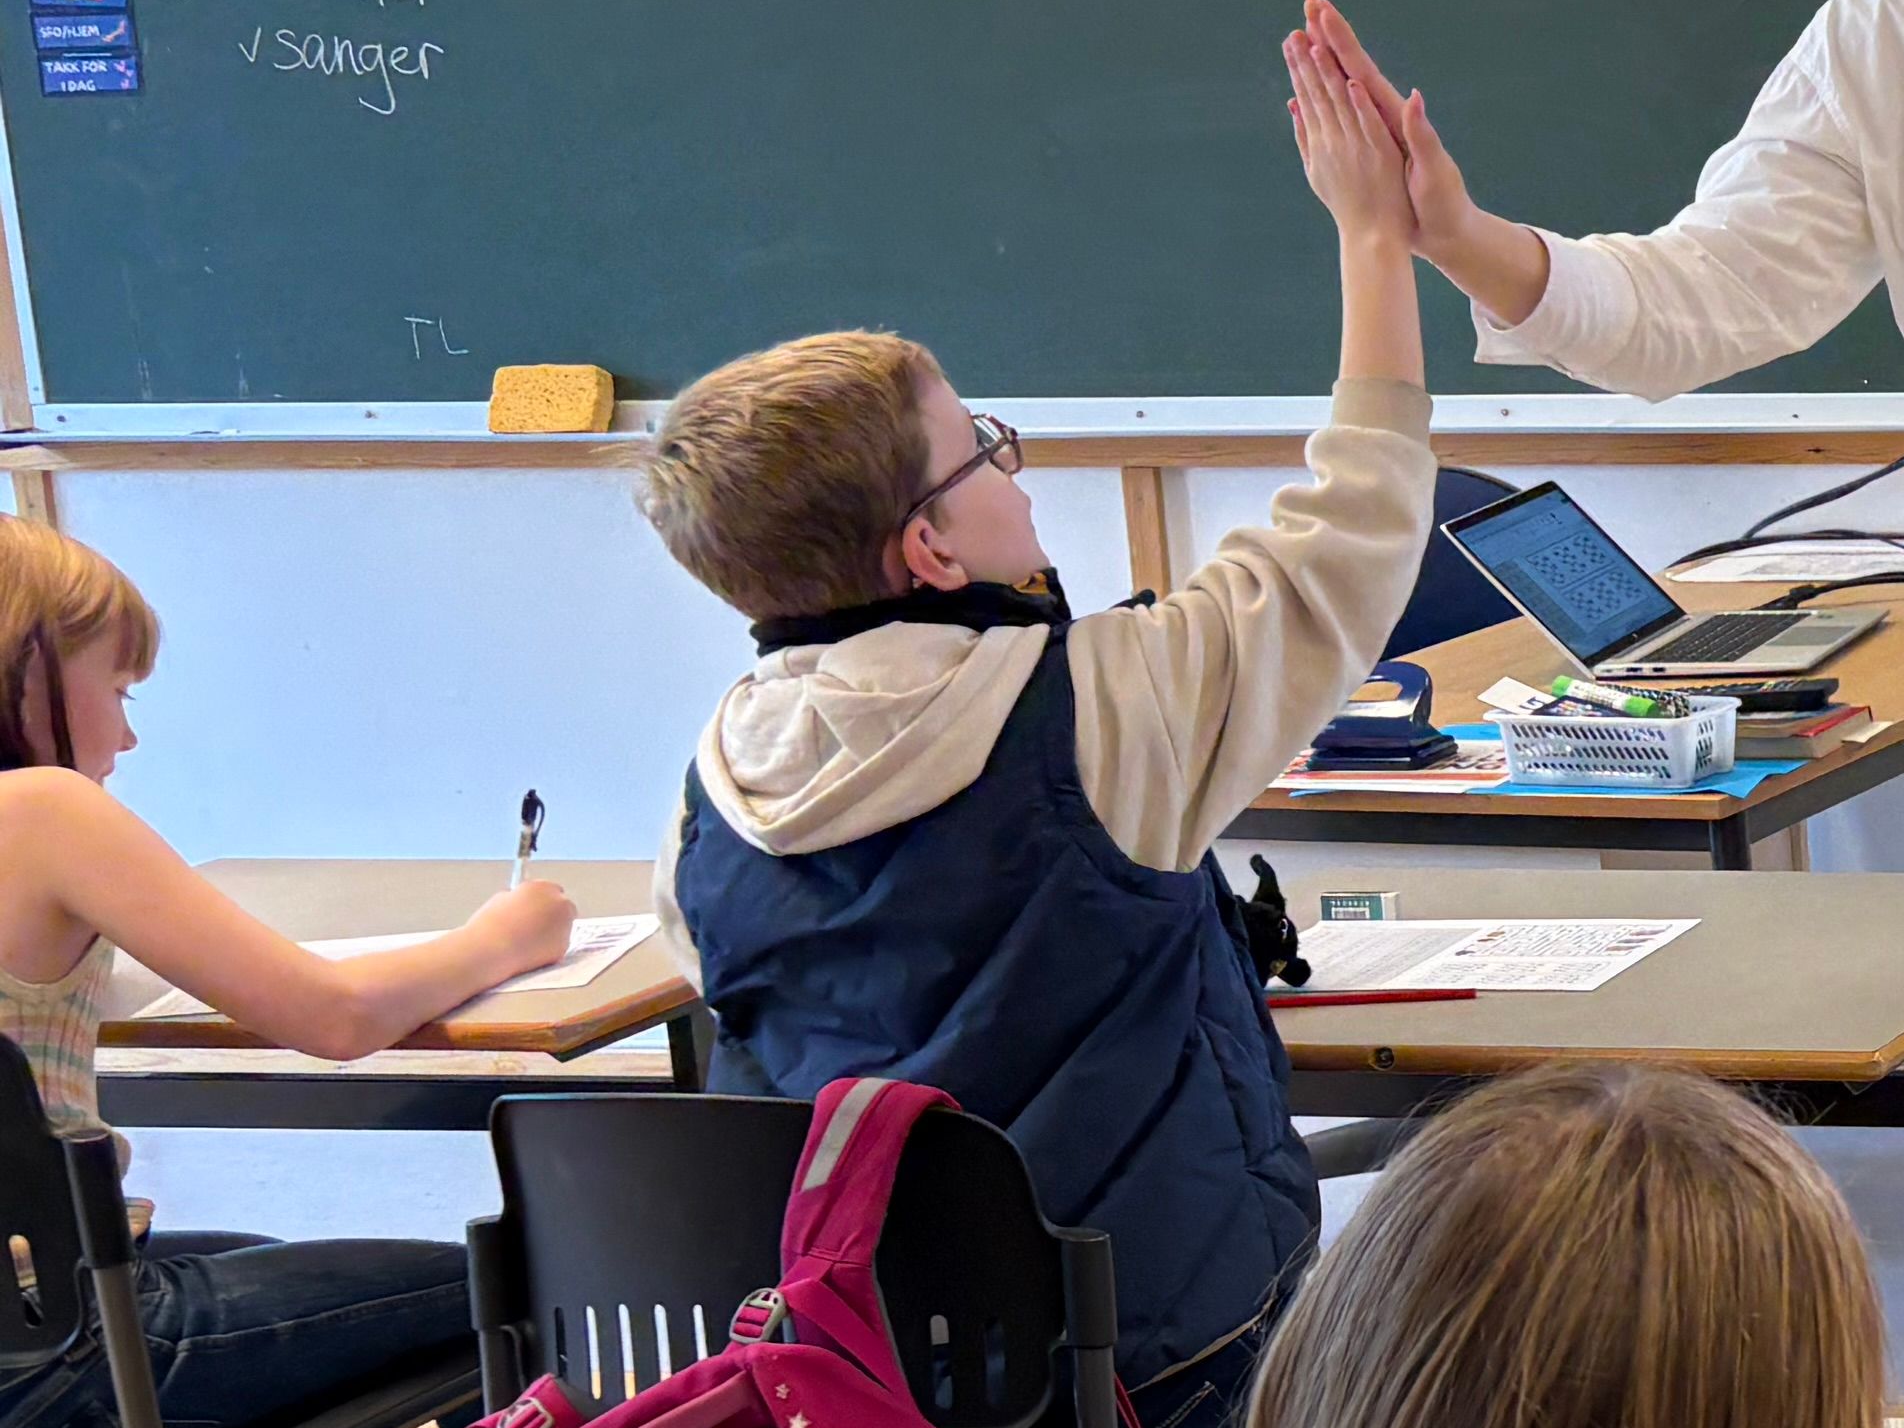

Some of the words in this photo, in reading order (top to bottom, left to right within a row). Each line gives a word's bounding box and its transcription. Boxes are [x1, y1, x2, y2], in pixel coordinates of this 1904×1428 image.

[43, 60, 80, 74] TAKK
[81, 60, 108, 74] FOR
[273, 27, 445, 113] sanger
